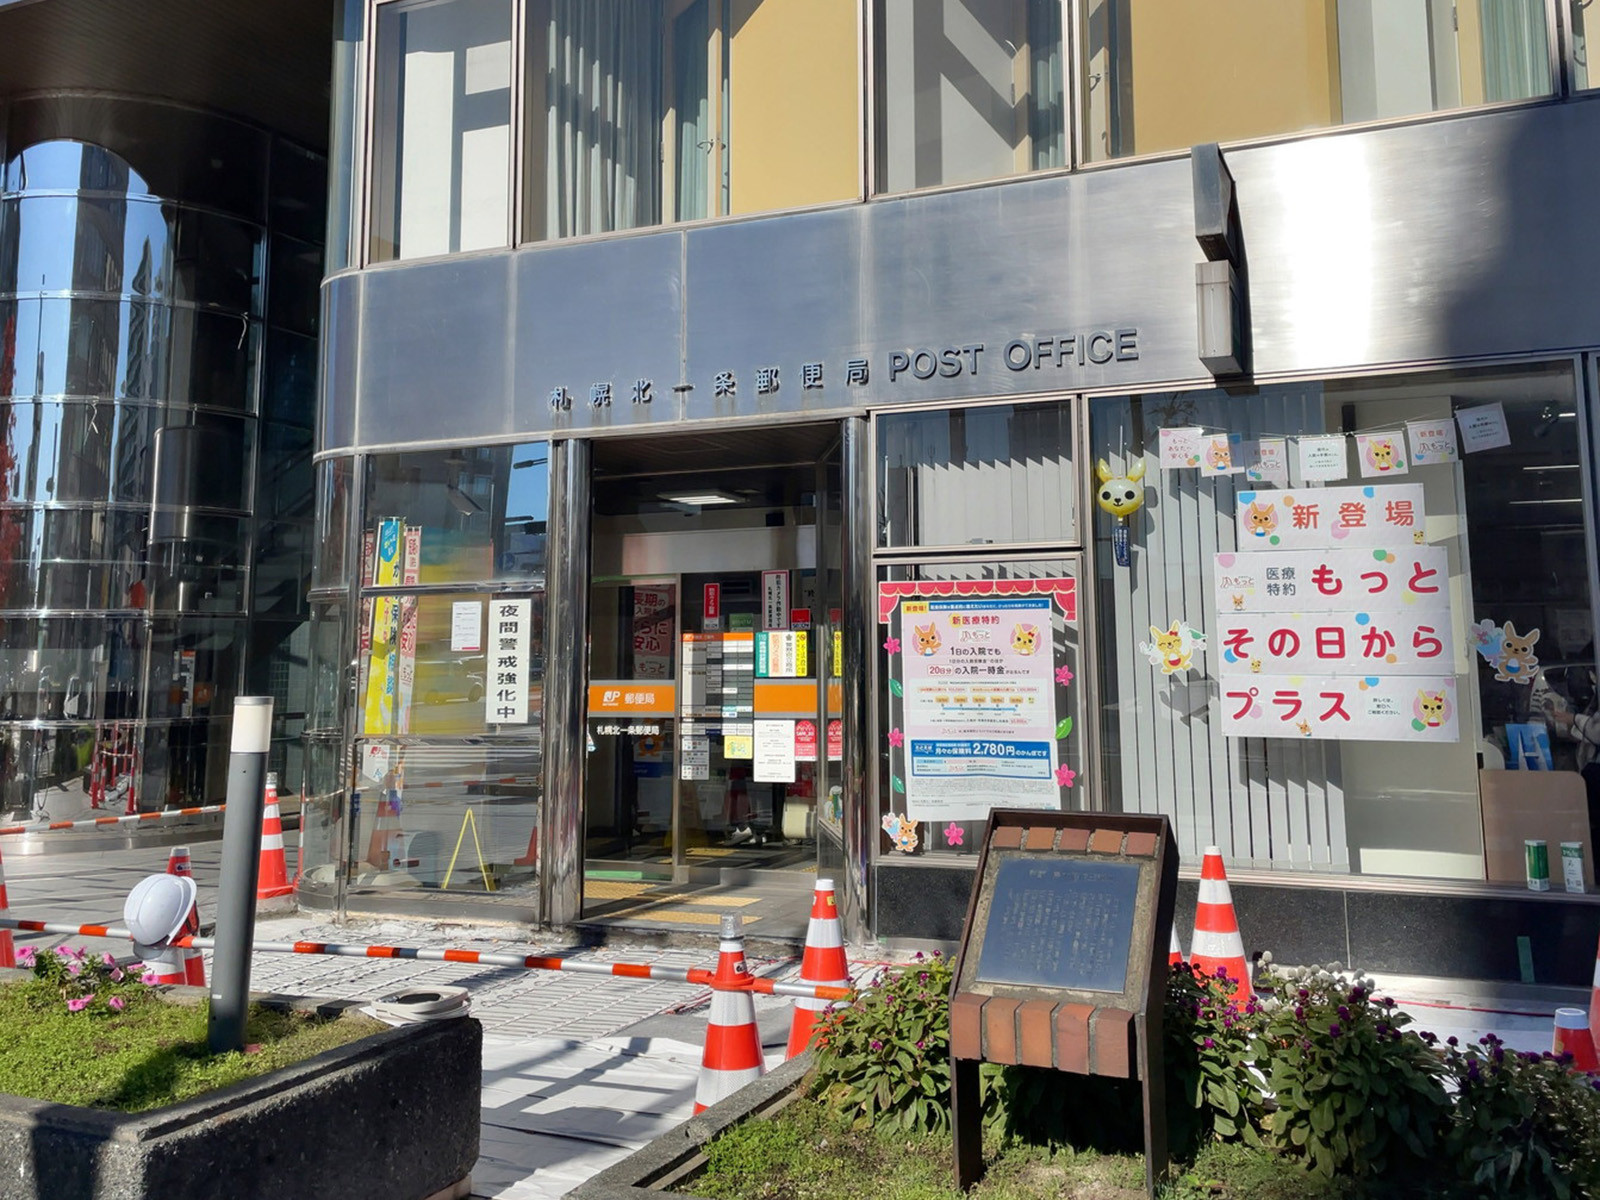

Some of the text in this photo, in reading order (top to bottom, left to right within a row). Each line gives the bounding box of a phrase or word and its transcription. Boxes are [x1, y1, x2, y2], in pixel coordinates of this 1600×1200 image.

[549, 328, 1139, 409] 札幌北一条郵便局 POST OFFICE
[1292, 500, 1414, 529] 新登場
[1266, 567, 1295, 580] 医療
[1311, 562, 1439, 596] もっと
[1267, 583, 1296, 596] 特約
[951, 616, 999, 625] 新医療特約
[1223, 625, 1443, 659] その日から
[496, 604, 519, 719] 夜間警戒強化中
[625, 692, 655, 704] 郵便局
[1226, 687, 1351, 722] プラス
